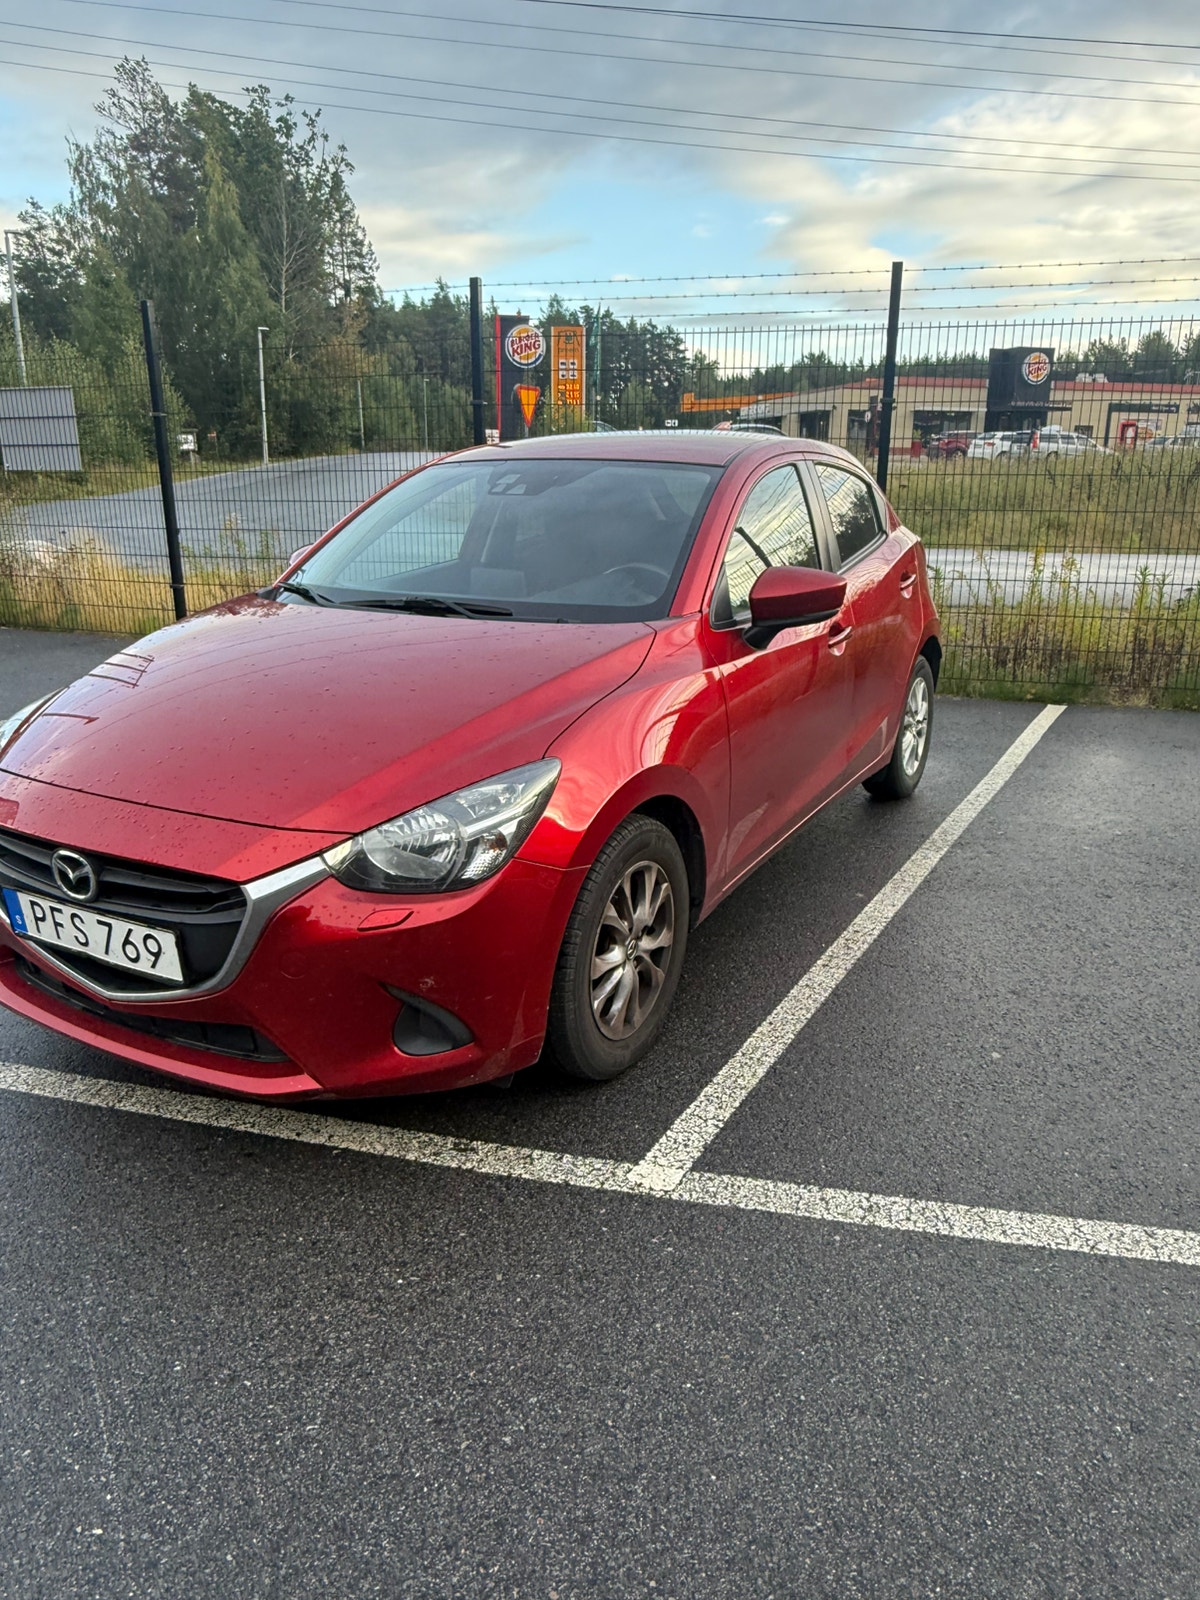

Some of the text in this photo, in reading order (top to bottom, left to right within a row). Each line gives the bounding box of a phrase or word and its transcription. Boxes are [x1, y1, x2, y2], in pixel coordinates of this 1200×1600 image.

[512, 340, 541, 357] KING
[15, 915, 22, 925] S
[29, 899, 162, 969] PFS 769
